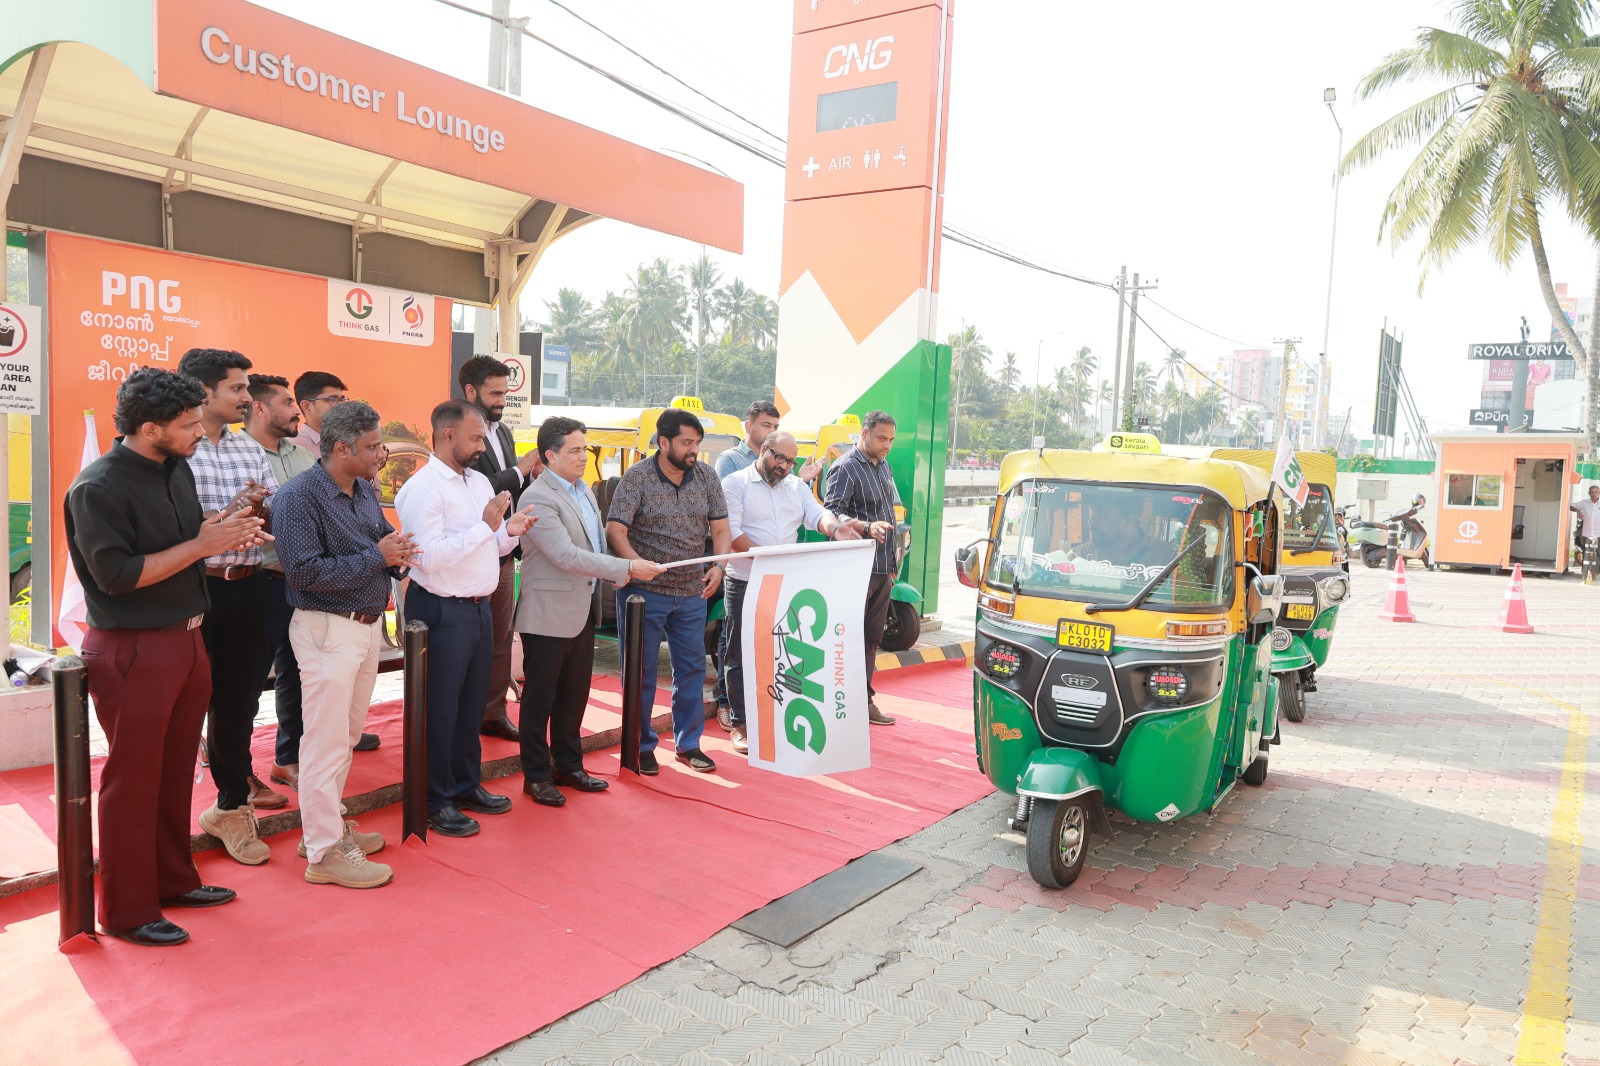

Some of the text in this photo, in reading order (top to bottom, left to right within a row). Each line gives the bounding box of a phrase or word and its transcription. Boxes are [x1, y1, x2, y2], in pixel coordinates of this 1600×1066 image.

[823, 35, 895, 79] CNG
[200, 26, 506, 154] Customer Lounge
[828, 156, 852, 172] AIR
[102, 270, 182, 314] PNG
[338, 320, 380, 332] THINK GAS
[1473, 345, 1521, 357] ROYAL
[0, 363, 29, 372] YOUR
[3, 373, 31, 383] AREA
[681, 398, 700, 409] TAXI
[1068, 622, 1106, 639] KL01D
[1068, 634, 1105, 649] C3032
[767, 605, 805, 707] Rally
[784, 588, 828, 755] CNG
[834, 641, 846, 720] THINK GAS
[1068, 677, 1090, 686] RE
[1158, 689, 1177, 697] 2x2
